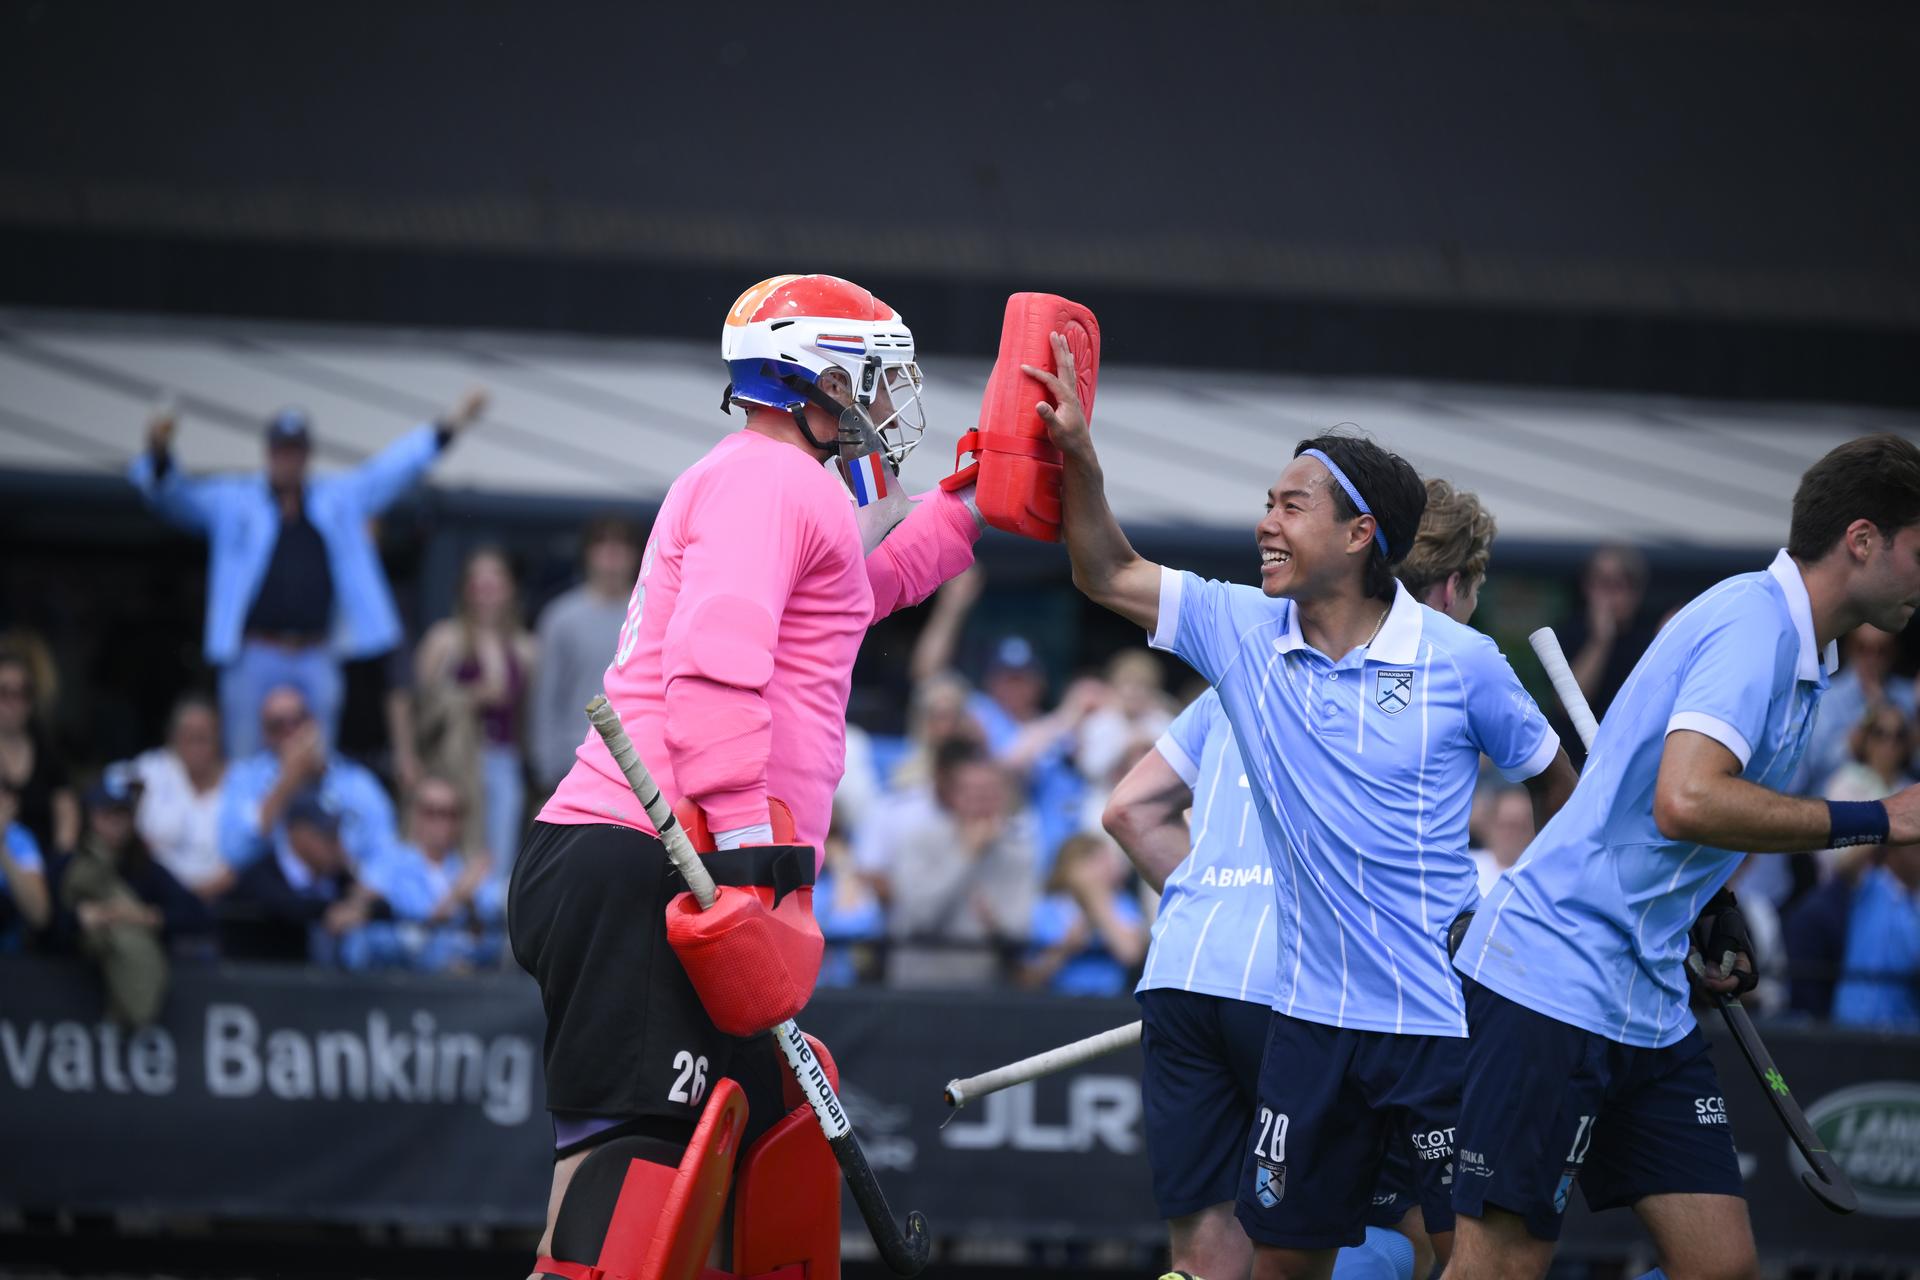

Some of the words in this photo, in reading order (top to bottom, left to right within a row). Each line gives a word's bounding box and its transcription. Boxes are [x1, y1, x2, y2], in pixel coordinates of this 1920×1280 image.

[205, 1003, 534, 1126] Banking
[667, 1050, 709, 1107] 26
[941, 1075, 1142, 1156] JLR
[1254, 1107, 1290, 1163] 28
